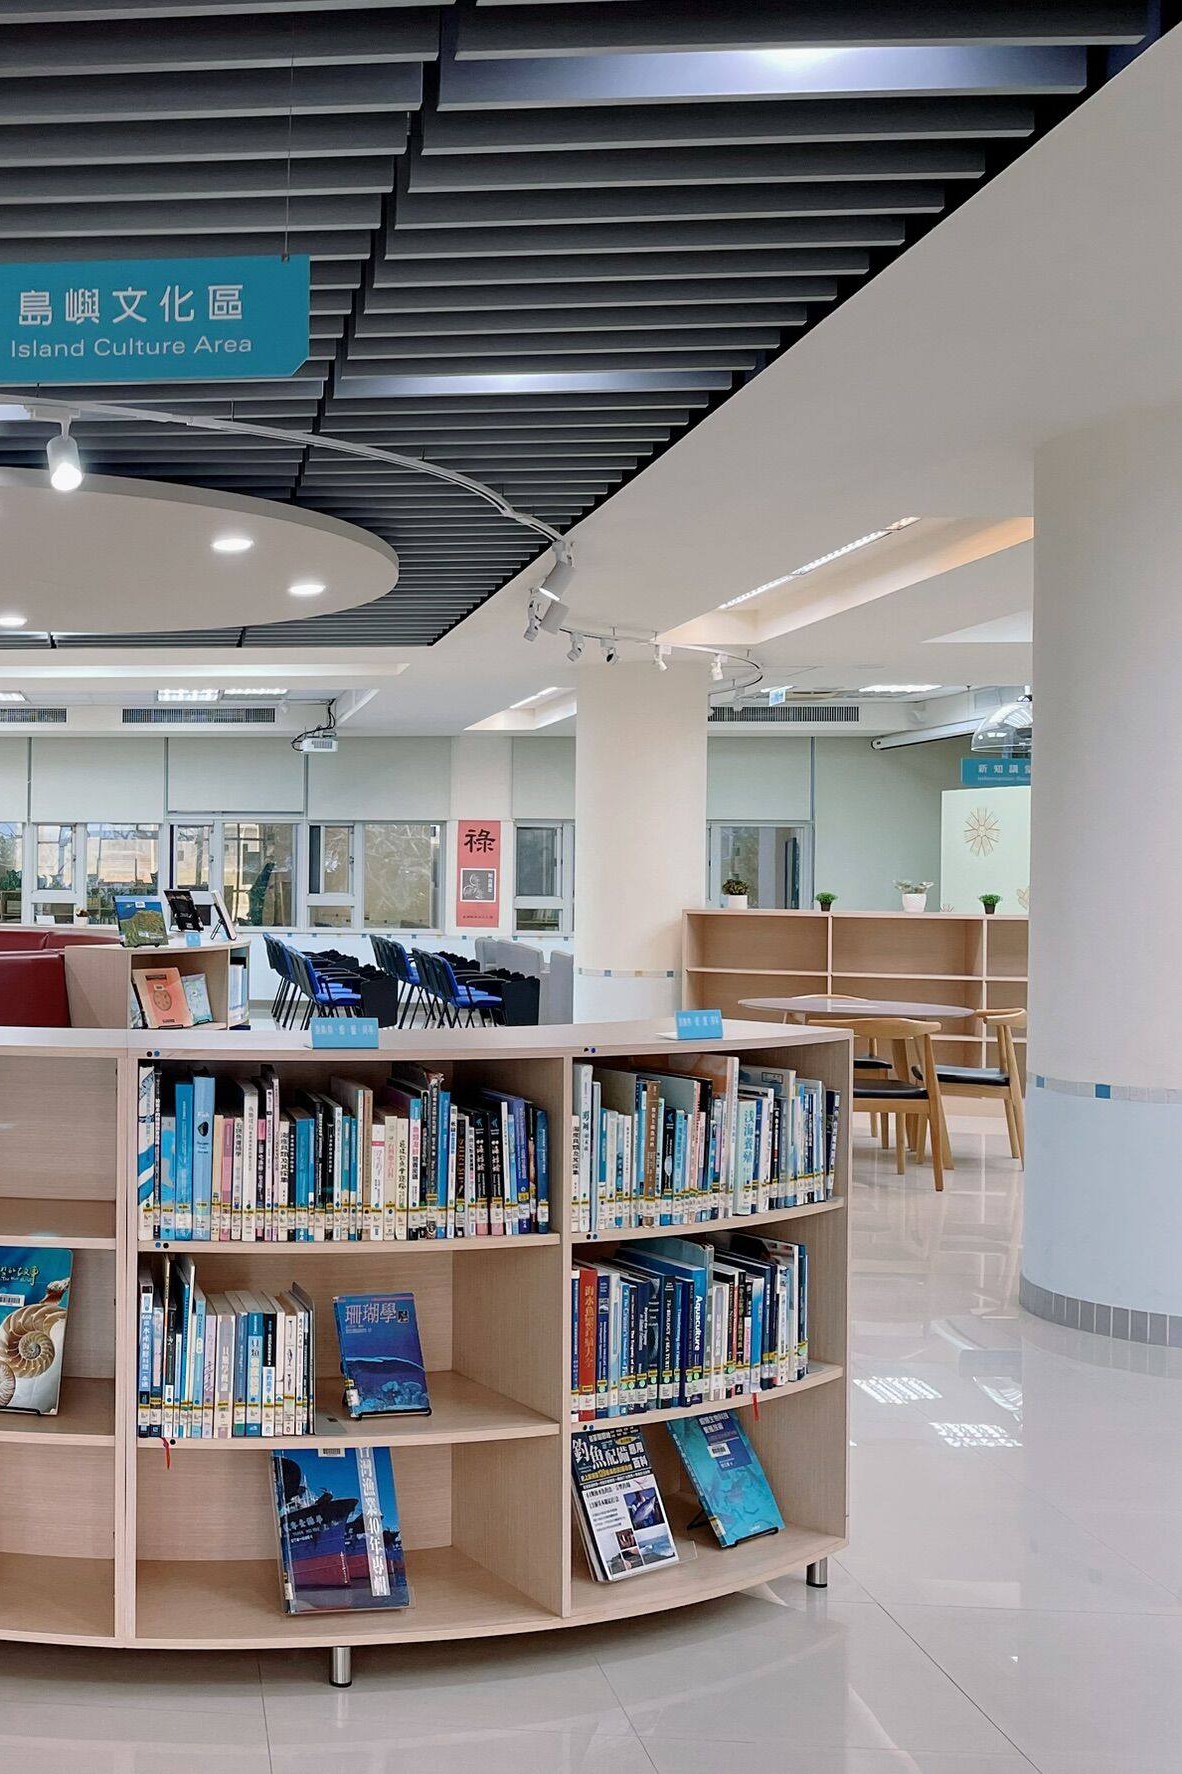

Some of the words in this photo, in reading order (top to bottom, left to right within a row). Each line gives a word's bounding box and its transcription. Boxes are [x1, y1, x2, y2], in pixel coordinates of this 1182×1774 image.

[18, 284, 244, 326] 島嶼文化區
[10, 339, 85, 358] Island
[93, 337, 186, 357] Culture
[194, 335, 252, 353] Area
[463, 828, 496, 853] 祿
[344, 1302, 397, 1324] 珊瑚學
[694, 1295, 703, 1351] Aquaculture
